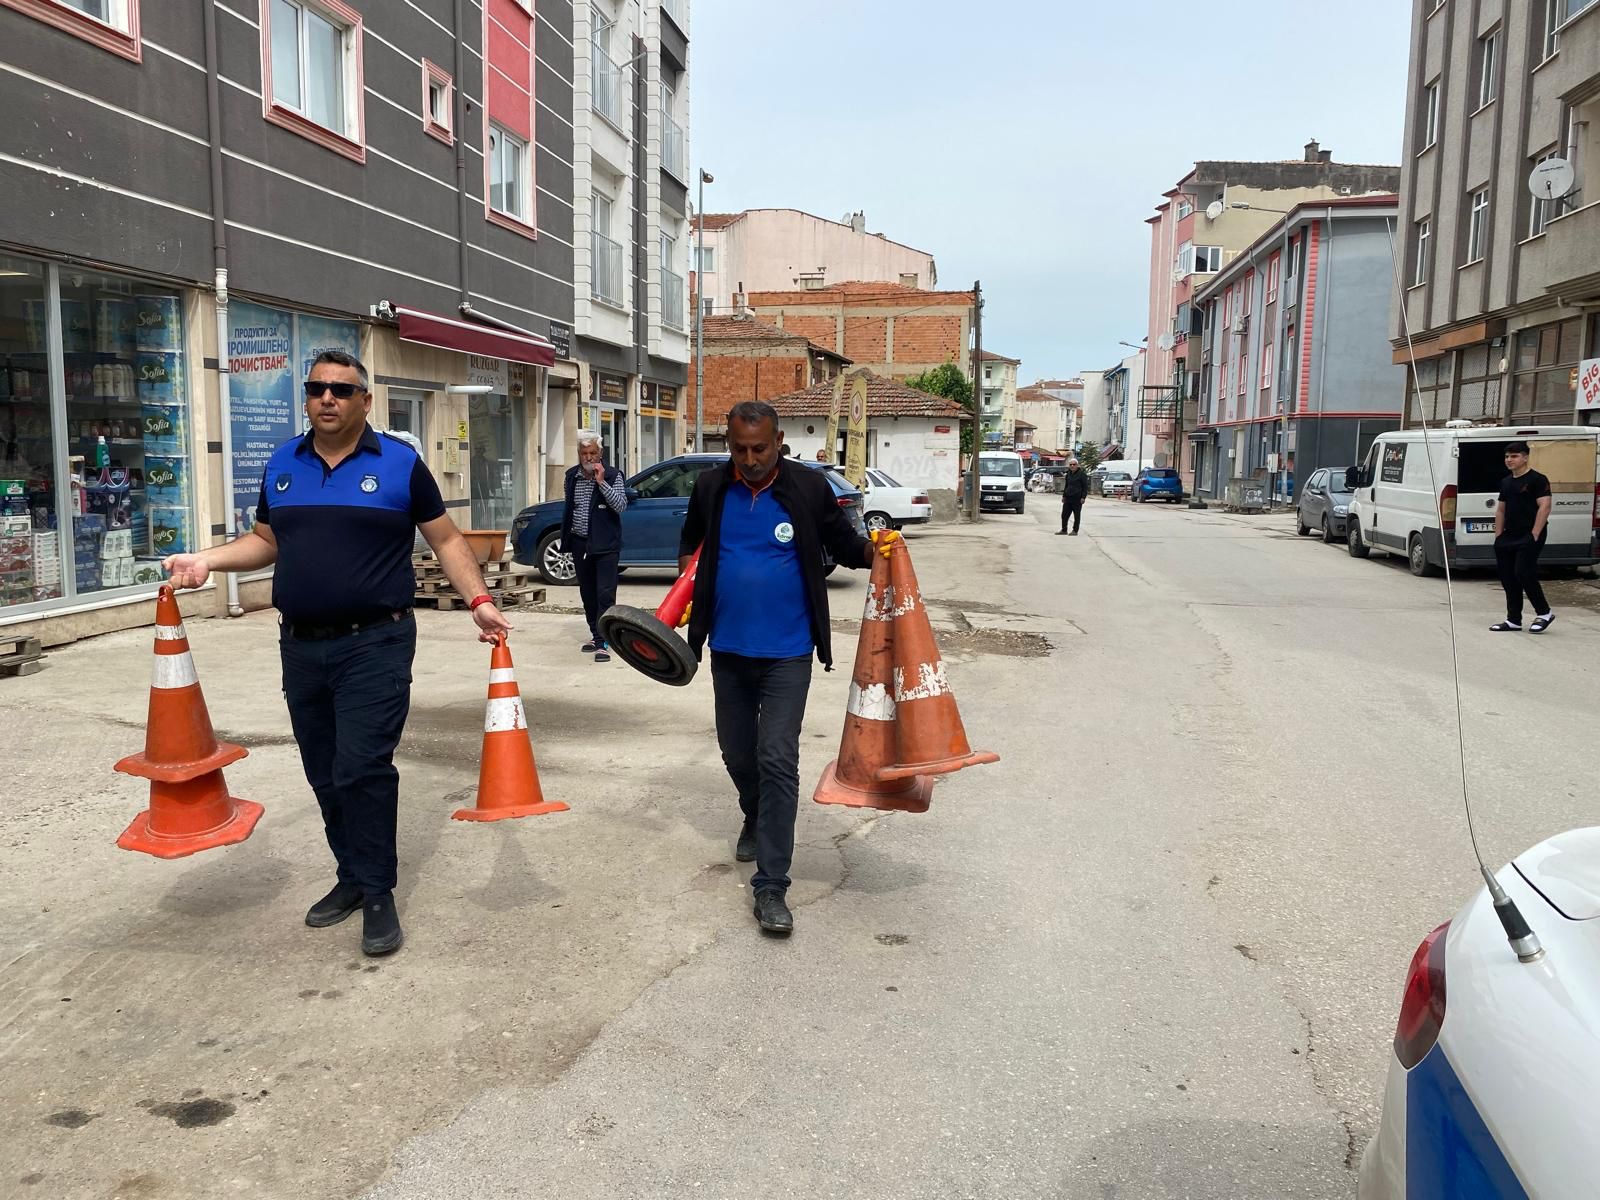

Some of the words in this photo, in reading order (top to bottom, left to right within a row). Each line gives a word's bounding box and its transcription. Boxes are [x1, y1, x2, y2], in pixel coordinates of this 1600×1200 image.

[136, 311, 162, 327] Sofia
[235, 328, 269, 339] ПРОДУКТИ
[269, 327, 278, 337] ЗА
[140, 365, 166, 380] Sofia
[1586, 378, 1600, 405] BA
[144, 418, 170, 433] Sofia
[149, 470, 173, 485] Sofia
[1471, 522, 1479, 531] 34
